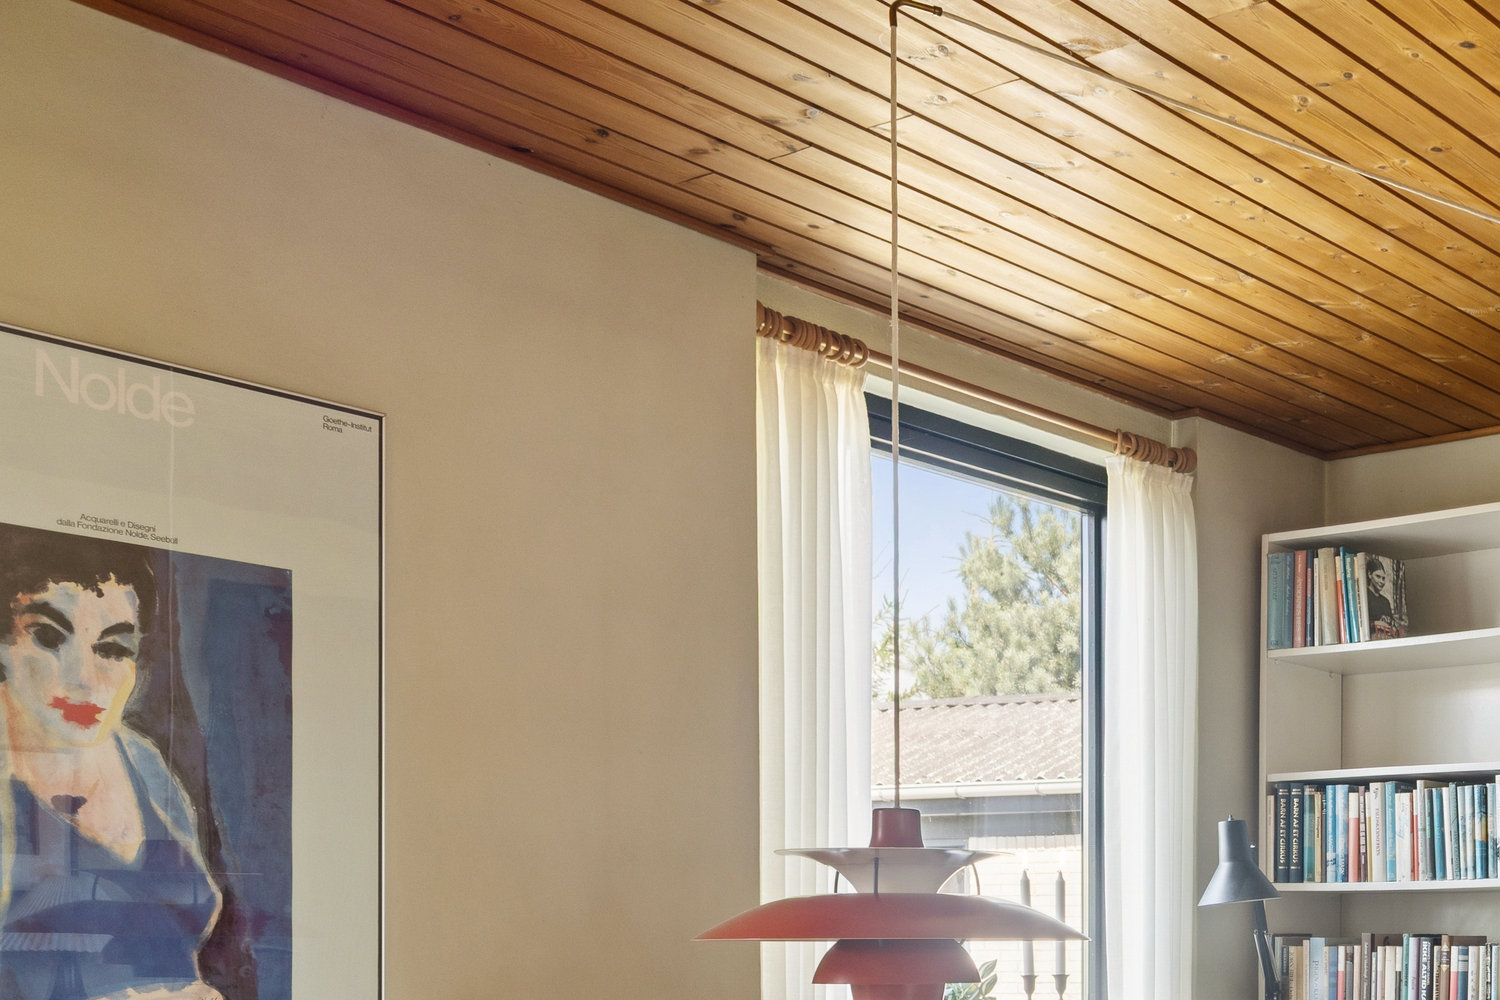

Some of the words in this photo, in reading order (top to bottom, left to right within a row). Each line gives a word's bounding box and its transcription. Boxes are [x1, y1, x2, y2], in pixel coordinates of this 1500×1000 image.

[35, 350, 196, 428] Nolde
[322, 423, 343, 433] Roma
[56, 519, 76, 528] dalla
[77, 520, 123, 536] Fondazione
[125, 528, 150, 541] Nolde,
[80, 513, 119, 526] Acquarelli
[127, 520, 156, 533] Disegni
[1280, 798, 1288, 818] BARN
[1292, 798, 1300, 818] BARN
[1280, 838, 1288, 864] CIRKUS
[1292, 838, 1300, 864] CIRKUS
